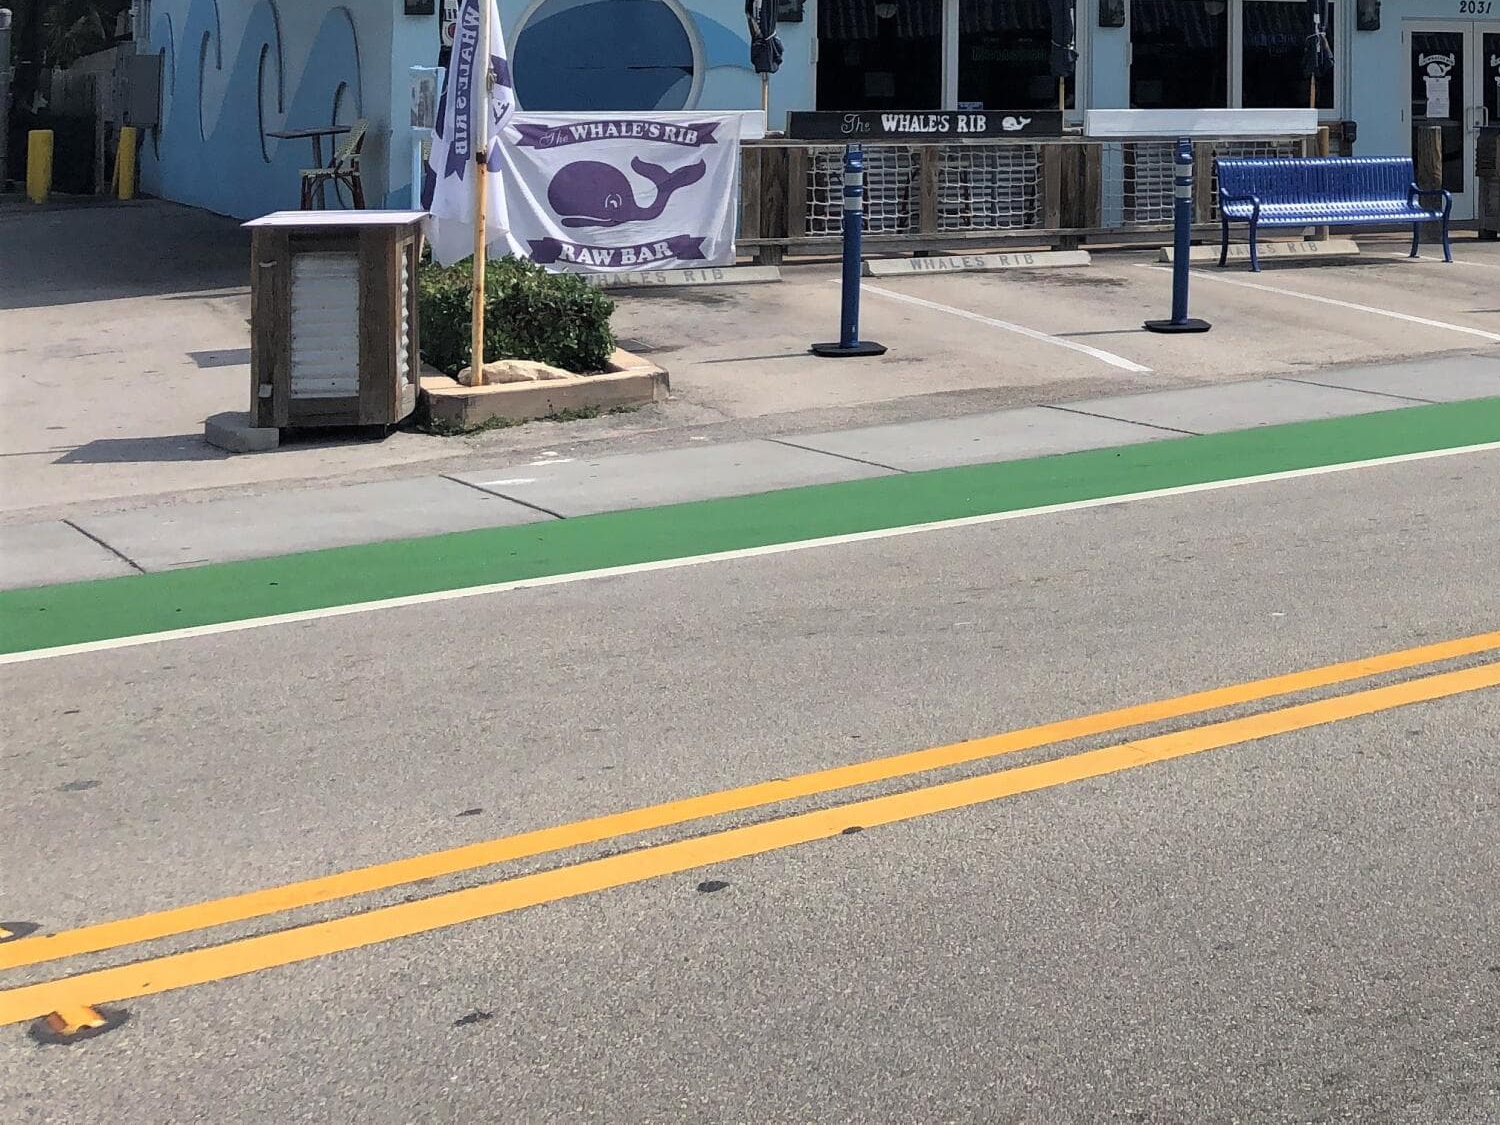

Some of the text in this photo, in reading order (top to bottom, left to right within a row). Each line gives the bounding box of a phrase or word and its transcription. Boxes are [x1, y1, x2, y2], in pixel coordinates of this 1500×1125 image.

[1459, 0, 1492, 14] 2031
[840, 113, 987, 133] The WHALE'S RIB
[539, 122, 698, 148] The WHALE'S RIB
[558, 241, 673, 267] RAW BAR
[910, 254, 1034, 271] WHALES RIB
[684, 268, 725, 283] RIB
